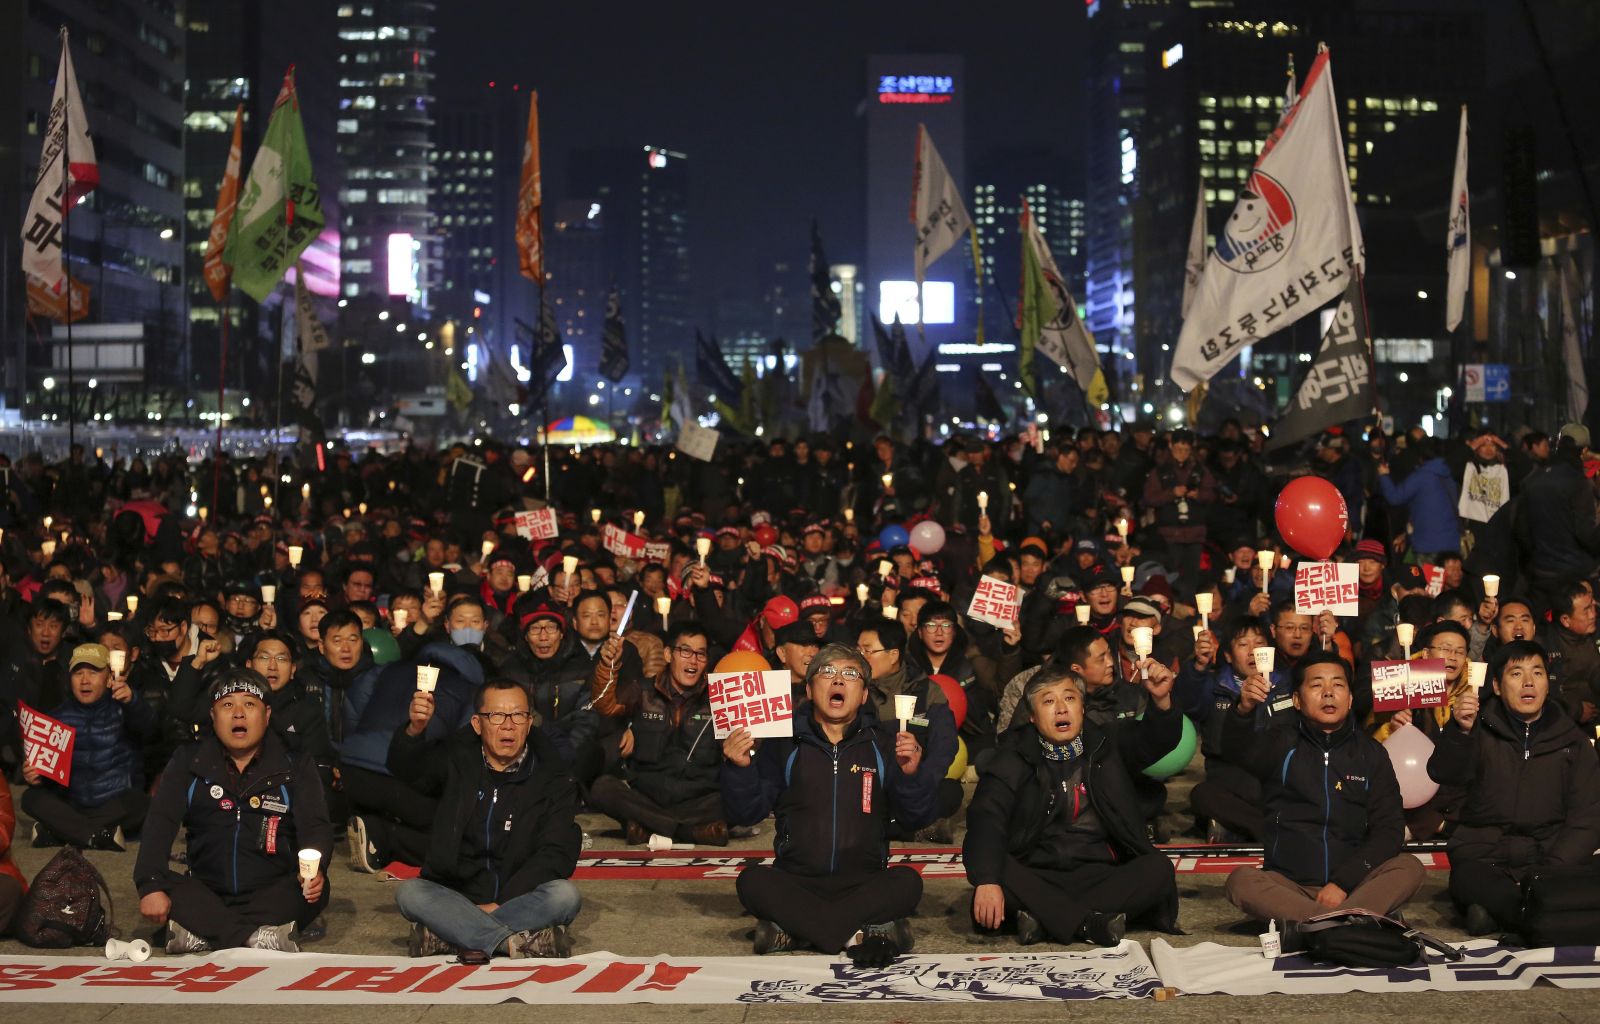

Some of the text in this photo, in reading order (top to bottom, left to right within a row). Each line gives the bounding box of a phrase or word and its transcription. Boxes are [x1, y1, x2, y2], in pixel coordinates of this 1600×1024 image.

[879, 75, 953, 92] 조선일보
[1295, 563, 1339, 588] 박근혜
[1297, 583, 1358, 609] 즉각퇴진
[972, 597, 1021, 621] 즉각퇴
[1372, 663, 1409, 682] 박근혜
[708, 671, 766, 705] 박근혜
[1374, 677, 1446, 702] 무조건 즉각퇴진!
[712, 693, 792, 732] 즉각퇴진
[19, 707, 72, 752] 박근혜
[0, 962, 271, 993] 정책
